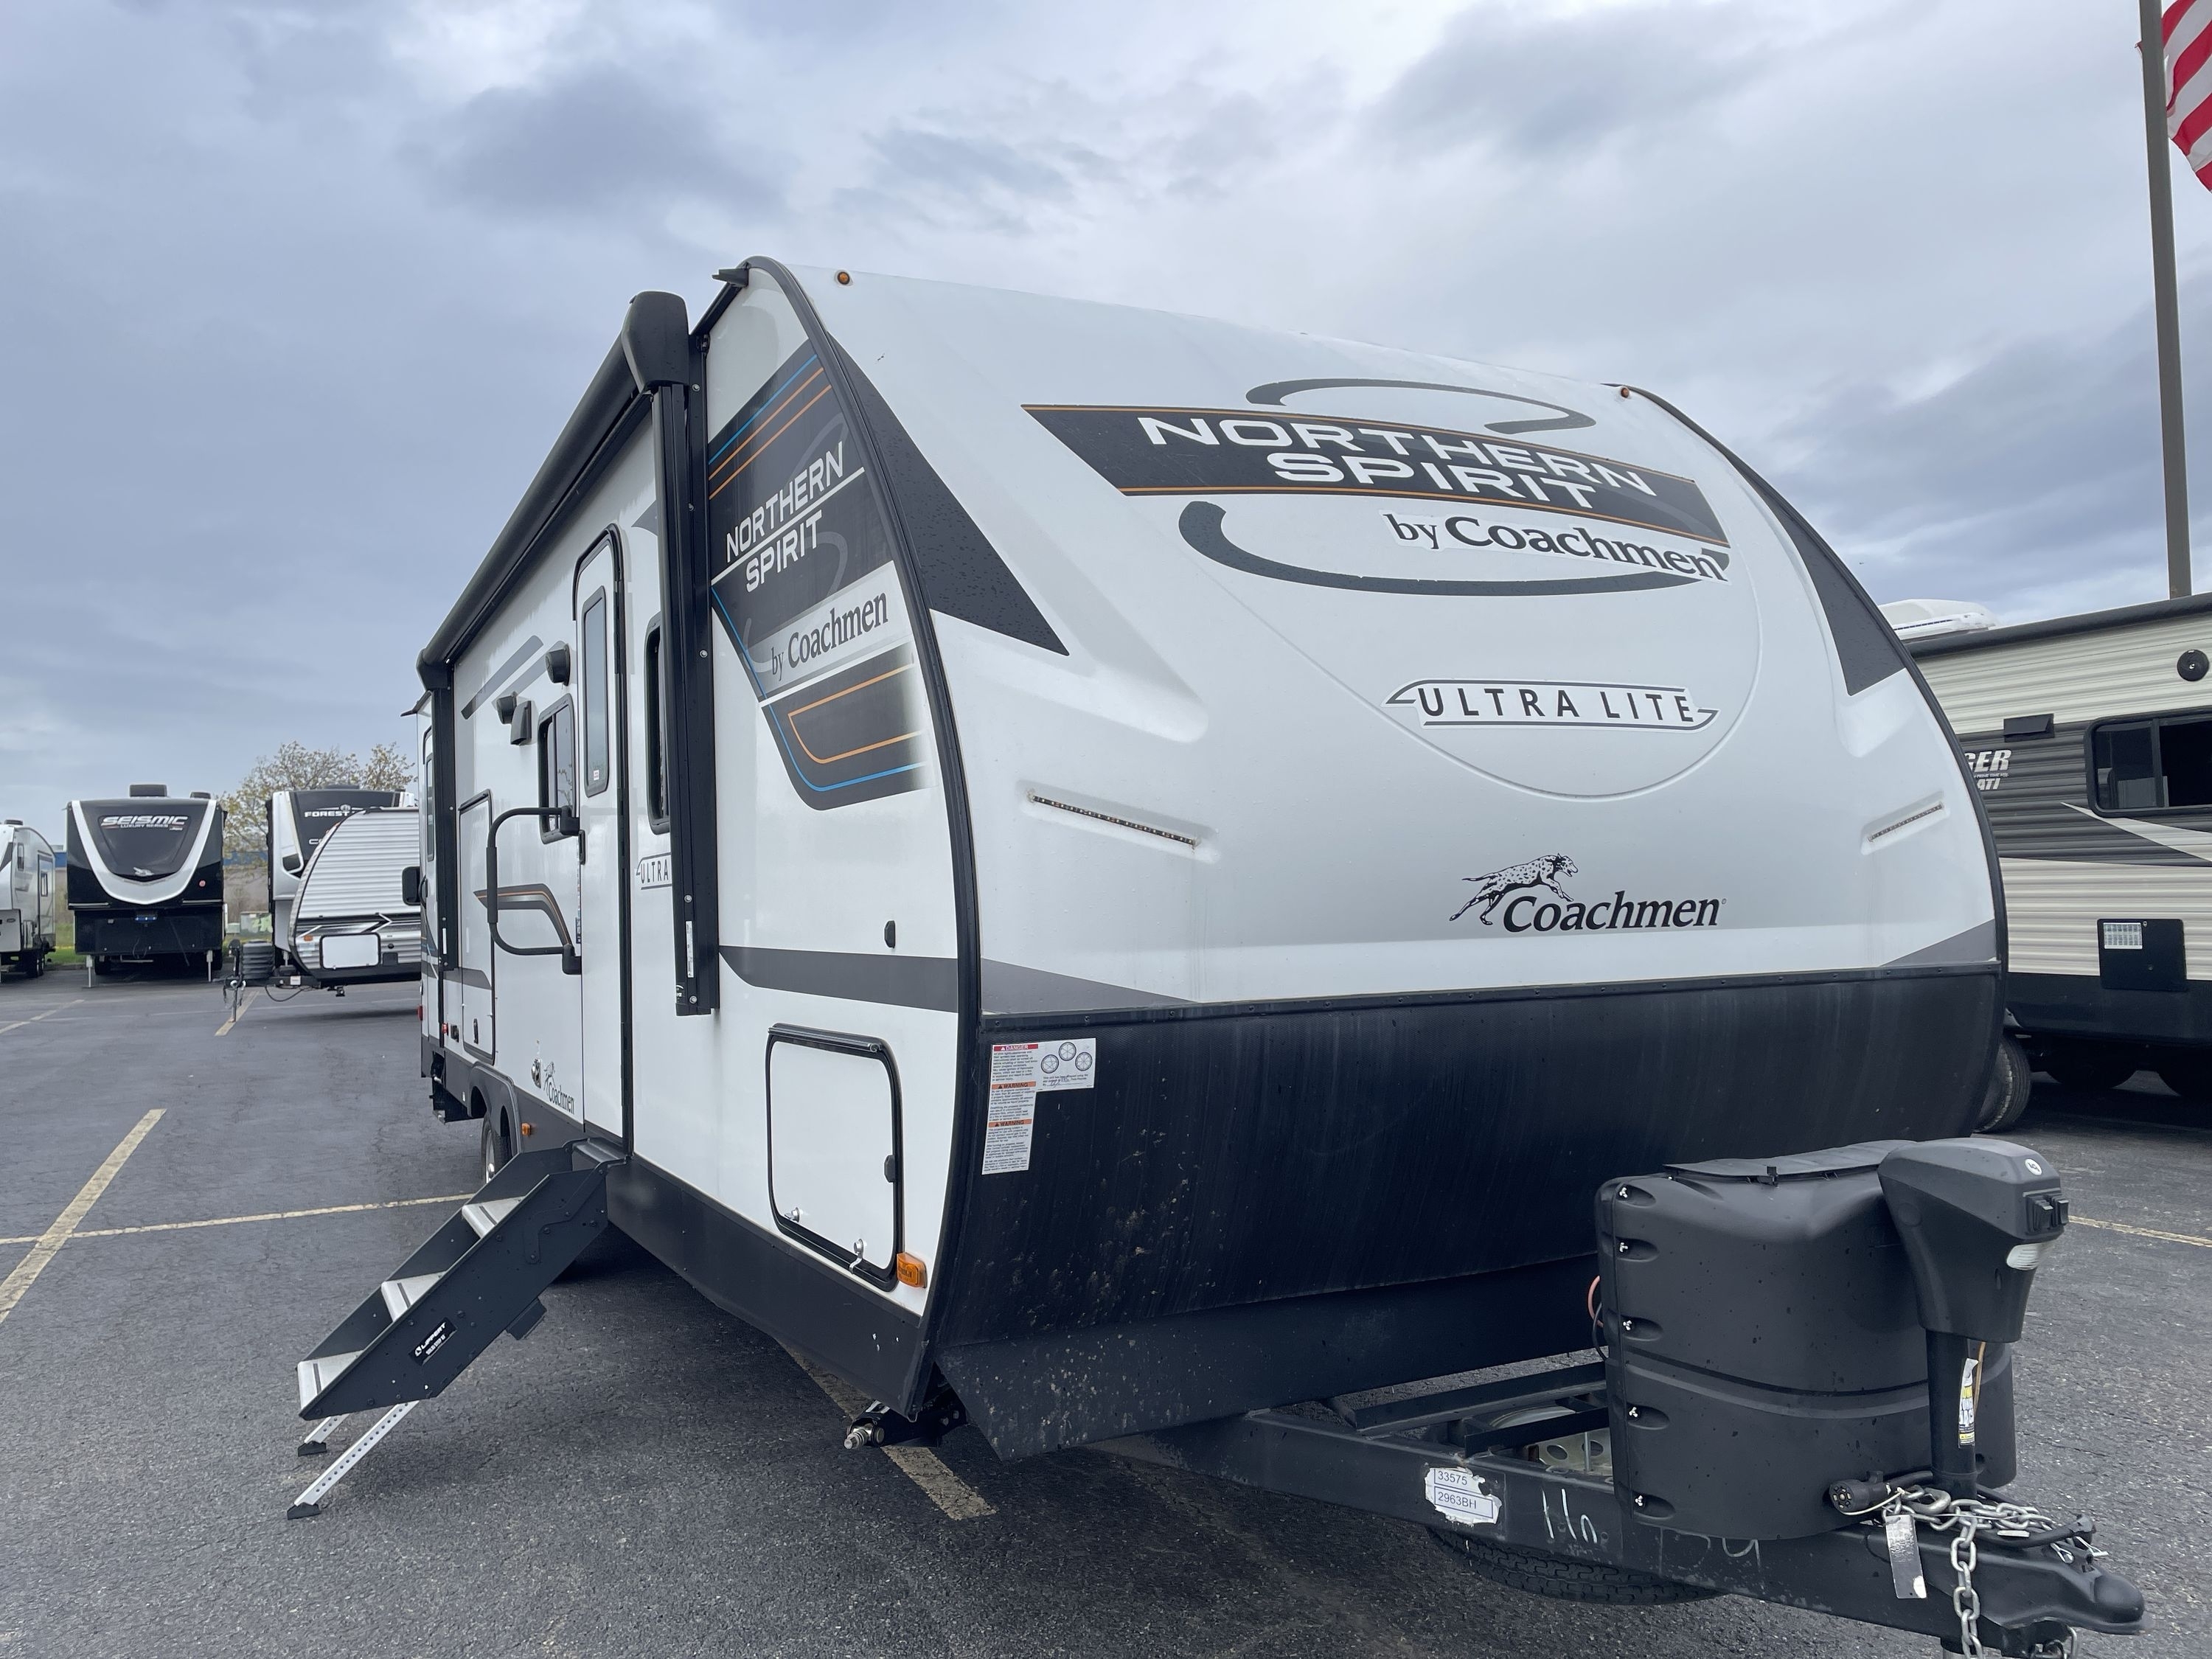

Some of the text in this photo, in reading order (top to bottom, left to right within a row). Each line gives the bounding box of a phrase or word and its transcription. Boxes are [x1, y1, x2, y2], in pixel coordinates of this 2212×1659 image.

[1136, 417, 1658, 496] NORTHERN
[726, 441, 844, 563] NORTHERN
[1266, 452, 1597, 509] SPIRIT
[745, 509, 823, 593] SPIRIT
[1382, 513, 1729, 582] by Coachmen
[771, 592, 888, 681] by Coachmen
[1417, 687, 1695, 723] ULTRA LITE
[100, 815, 189, 827] SEISMIC
[641, 858, 669, 884] ULTRA
[1503, 890, 1721, 933] Coachmen
[549, 1082, 574, 1115] Coachmen
[1438, 1470, 1467, 1486] 33575
[1438, 1491, 1477, 1509] 2963BH
